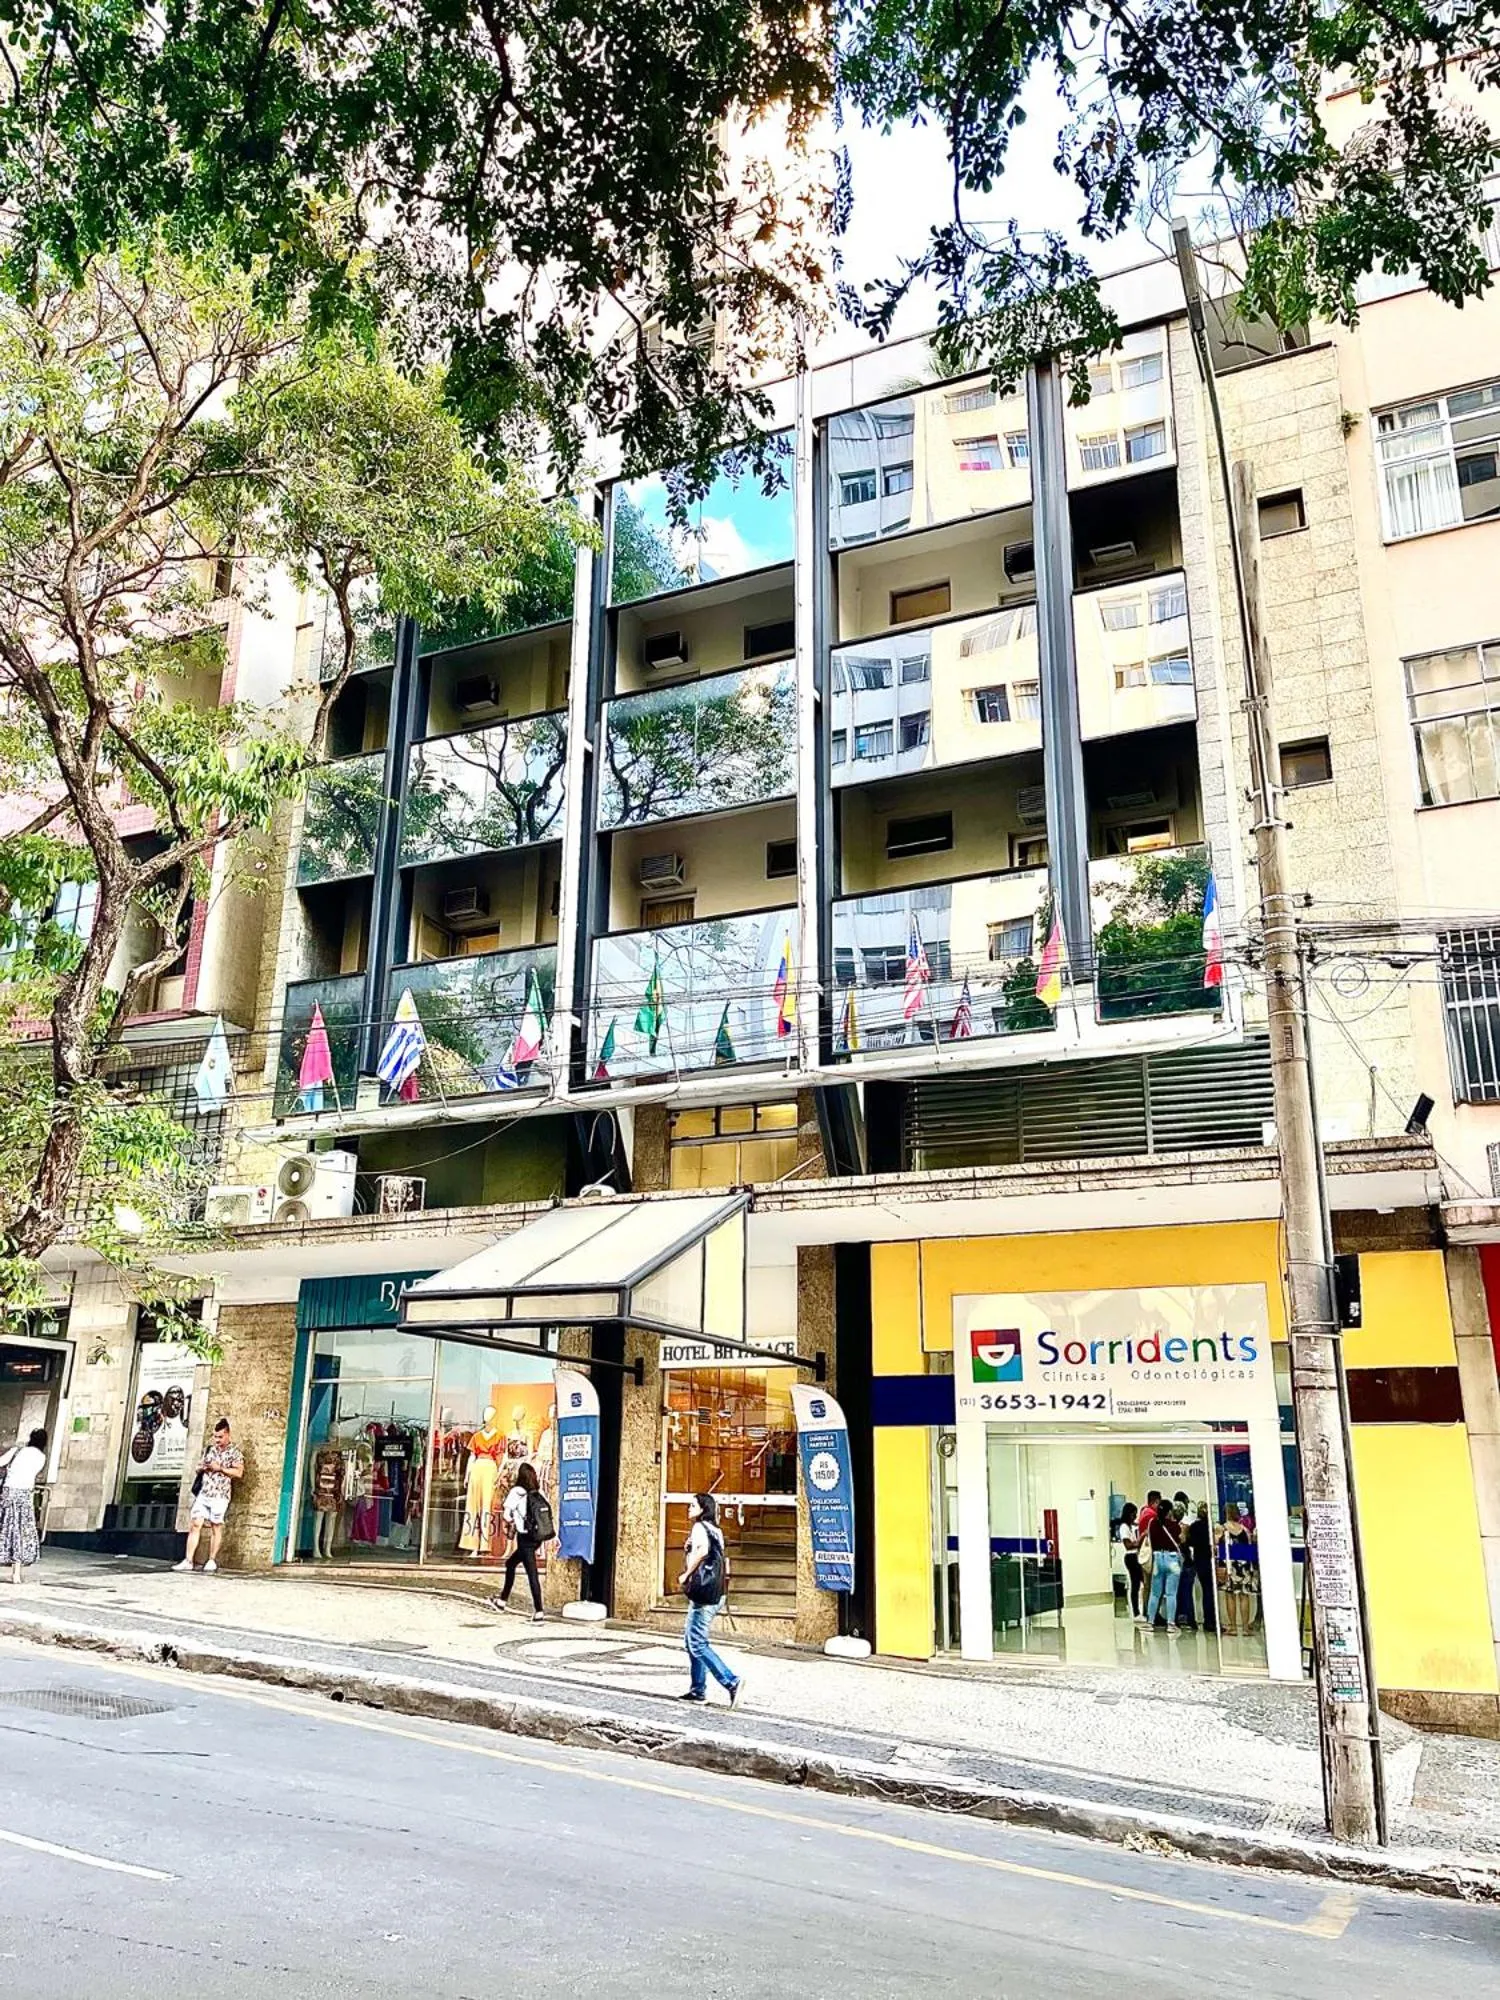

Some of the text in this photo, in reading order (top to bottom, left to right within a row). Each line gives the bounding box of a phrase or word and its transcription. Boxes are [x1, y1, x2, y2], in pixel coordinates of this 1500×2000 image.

[663, 1346, 710, 1361] HOTEL
[714, 1344, 733, 1359] BH
[1037, 1330, 1257, 1365] Sorridents
[1131, 1369, 1255, 1382] Odontológicas
[980, 1394, 1106, 1410] 3653-1942
[1156, 1468, 1169, 1477] do
